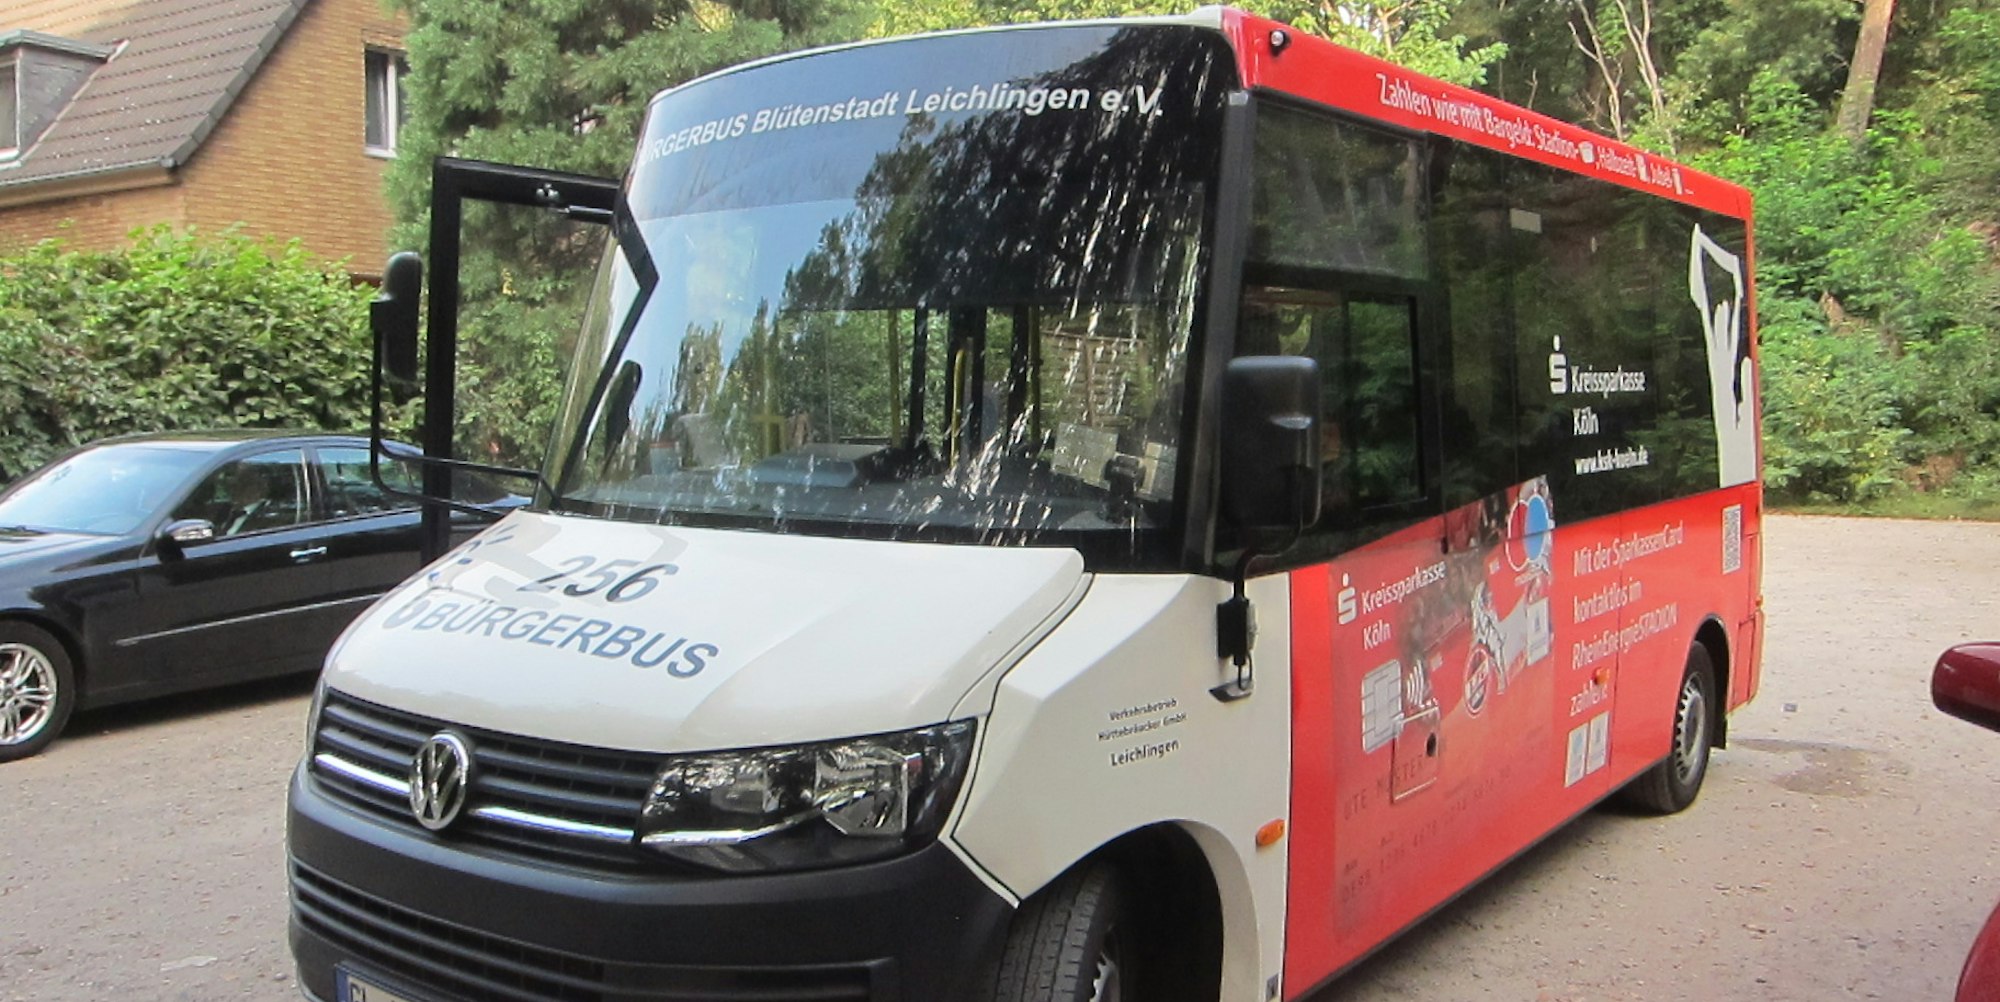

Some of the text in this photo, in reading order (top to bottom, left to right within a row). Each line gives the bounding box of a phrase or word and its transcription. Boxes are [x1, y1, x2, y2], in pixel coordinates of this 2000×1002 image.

[640, 113, 749, 164] RGERBUS
[752, 92, 898, 134] Blütenstadt
[904, 84, 1090, 116] Leichlingen
[1375, 73, 1432, 117] Zahlen
[1431, 93, 1459, 126] wie
[1460, 103, 1484, 133] mit
[1571, 365, 1646, 399] Kreissparkasse
[1573, 406, 1600, 436] Köln
[1573, 546, 1592, 577] Mit
[1593, 541, 1611, 571] der
[1612, 519, 1684, 570] SparkassenCard
[516, 555, 680, 603] 256
[1361, 561, 1447, 615] Kreissparkasse
[1573, 576, 1642, 624] kontaktlos im
[411, 597, 720, 679] BÜRGERBUS
[1363, 619, 1392, 651] Köln
[1110, 740, 1180, 767] Leichlingen
